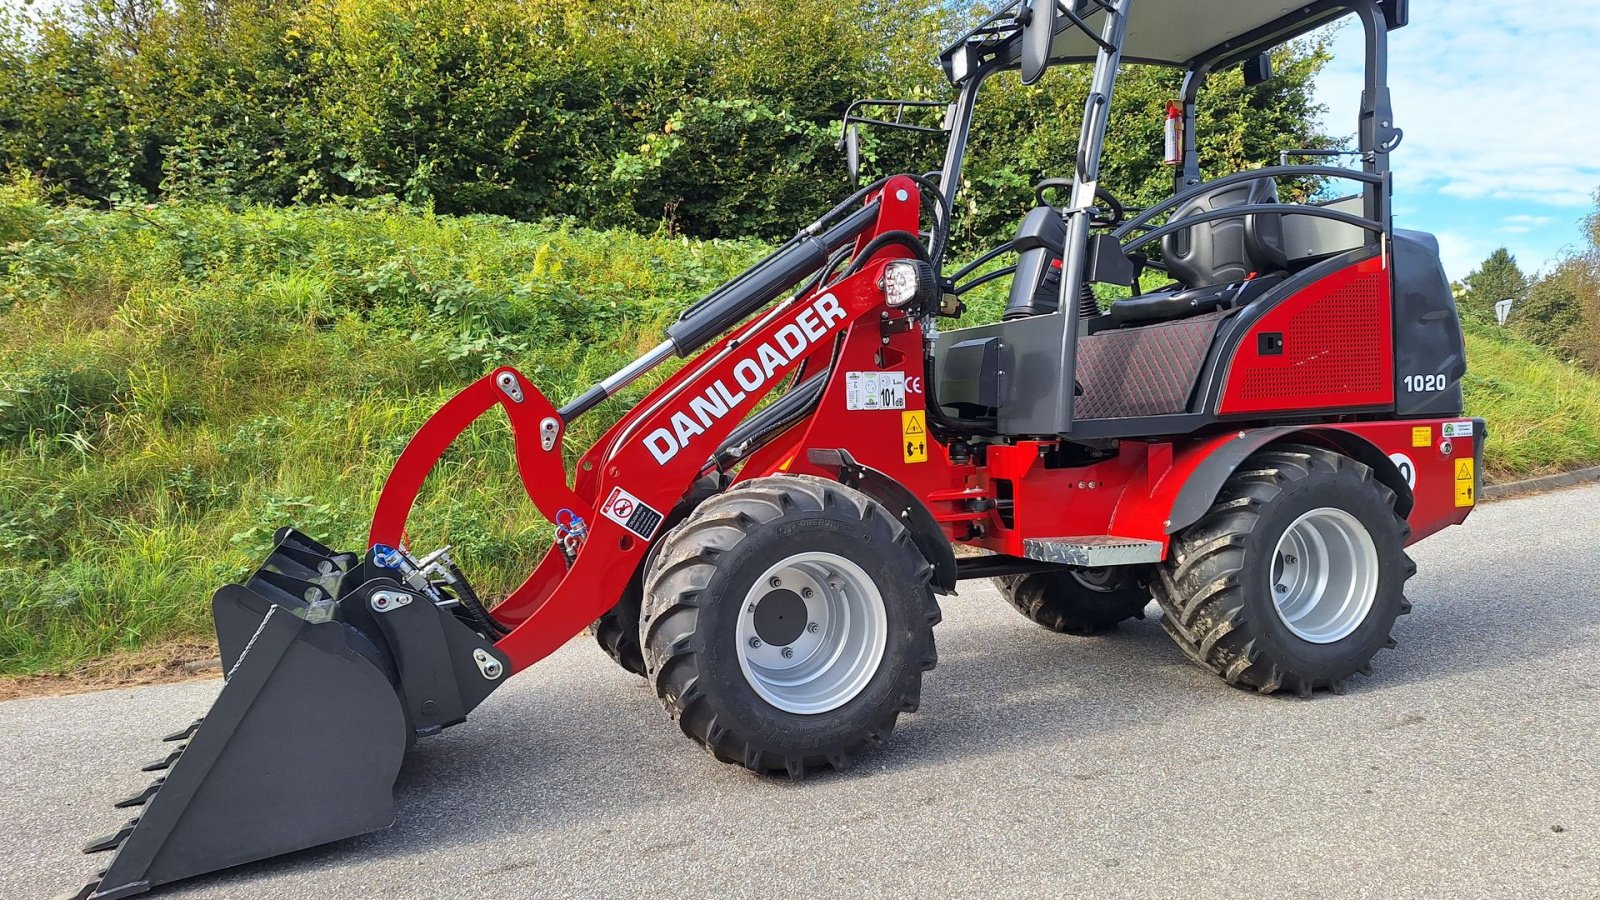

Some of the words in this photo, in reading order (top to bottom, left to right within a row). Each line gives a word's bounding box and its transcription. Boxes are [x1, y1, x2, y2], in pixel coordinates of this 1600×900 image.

[642, 292, 847, 466] DANLOADER
[1404, 374, 1446, 392] 1020
[881, 388, 895, 407] 101
[896, 398, 904, 407] dB
[1399, 462, 1411, 484] 0
